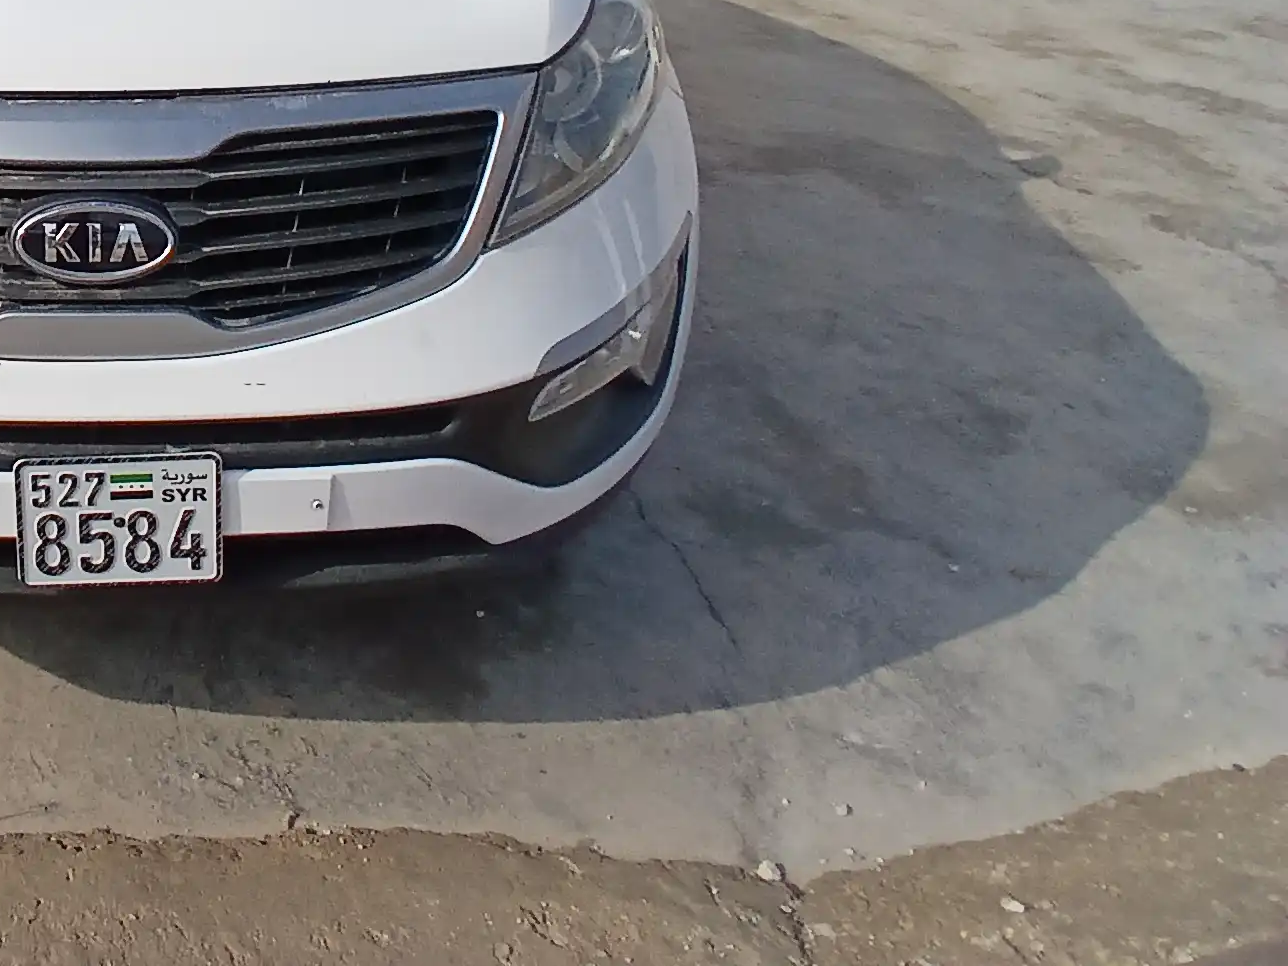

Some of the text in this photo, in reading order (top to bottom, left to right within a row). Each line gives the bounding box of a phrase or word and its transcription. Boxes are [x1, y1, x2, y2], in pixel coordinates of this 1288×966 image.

[43, 222, 149, 263] KIA
[30, 472, 106, 509] 527
[161, 468, 209, 485] سورية
[161, 487, 208, 503] SYR
[34, 508, 207, 576] 8584
